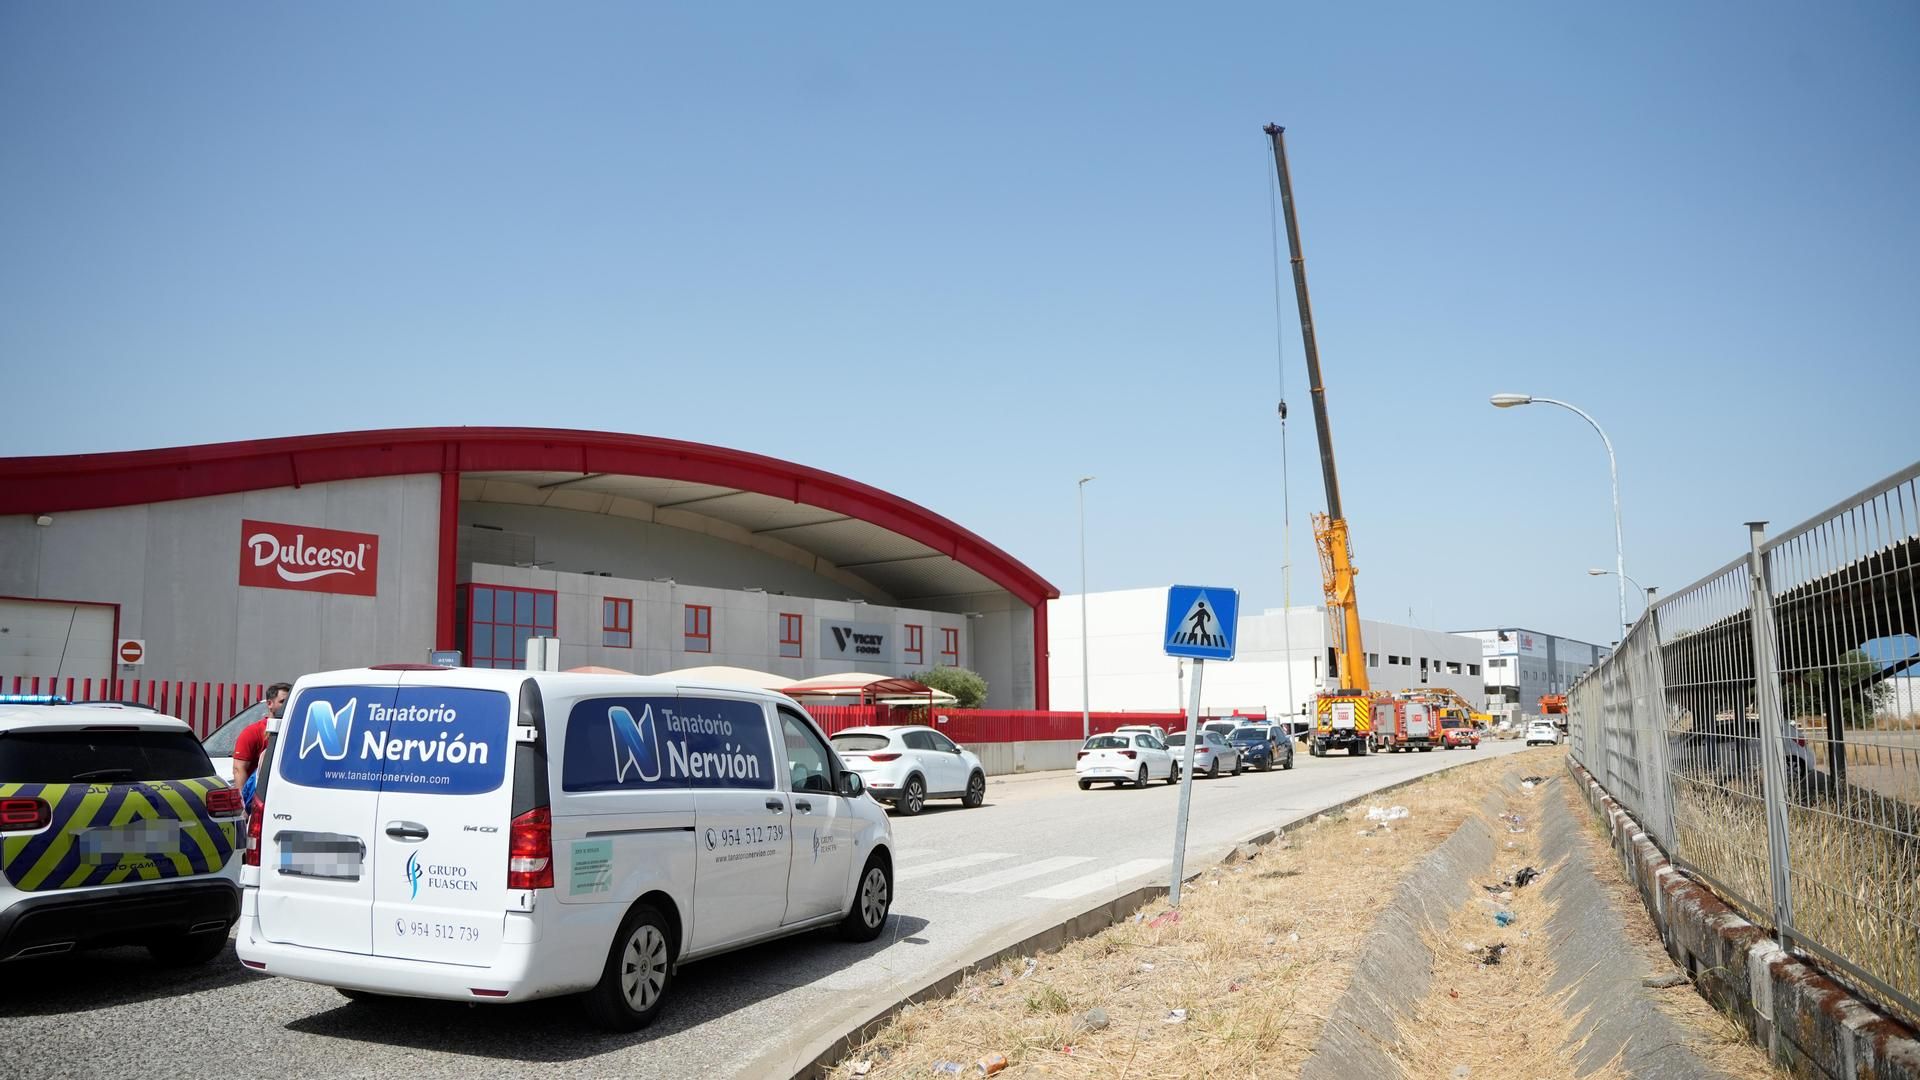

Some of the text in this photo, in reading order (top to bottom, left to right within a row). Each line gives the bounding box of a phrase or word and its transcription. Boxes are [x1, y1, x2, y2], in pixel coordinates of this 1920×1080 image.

[247, 533, 366, 571] Dulcesol
[853, 634, 883, 645] VICKY
[368, 703, 457, 723] Tanatorio
[661, 708, 733, 737] Tanatorio
[360, 730, 489, 765] Nervión
[666, 740, 760, 779] Nervión
[324, 770, 450, 785] www.tanatorionervion.com
[273, 813, 292, 821] VITO
[721, 824, 784, 847] 954 512 739
[715, 849, 777, 863] www.tanatorionervion.com
[428, 864, 467, 877] GRUPO
[428, 877, 479, 891] FUASCEN
[411, 922, 480, 942] 954 512 739
